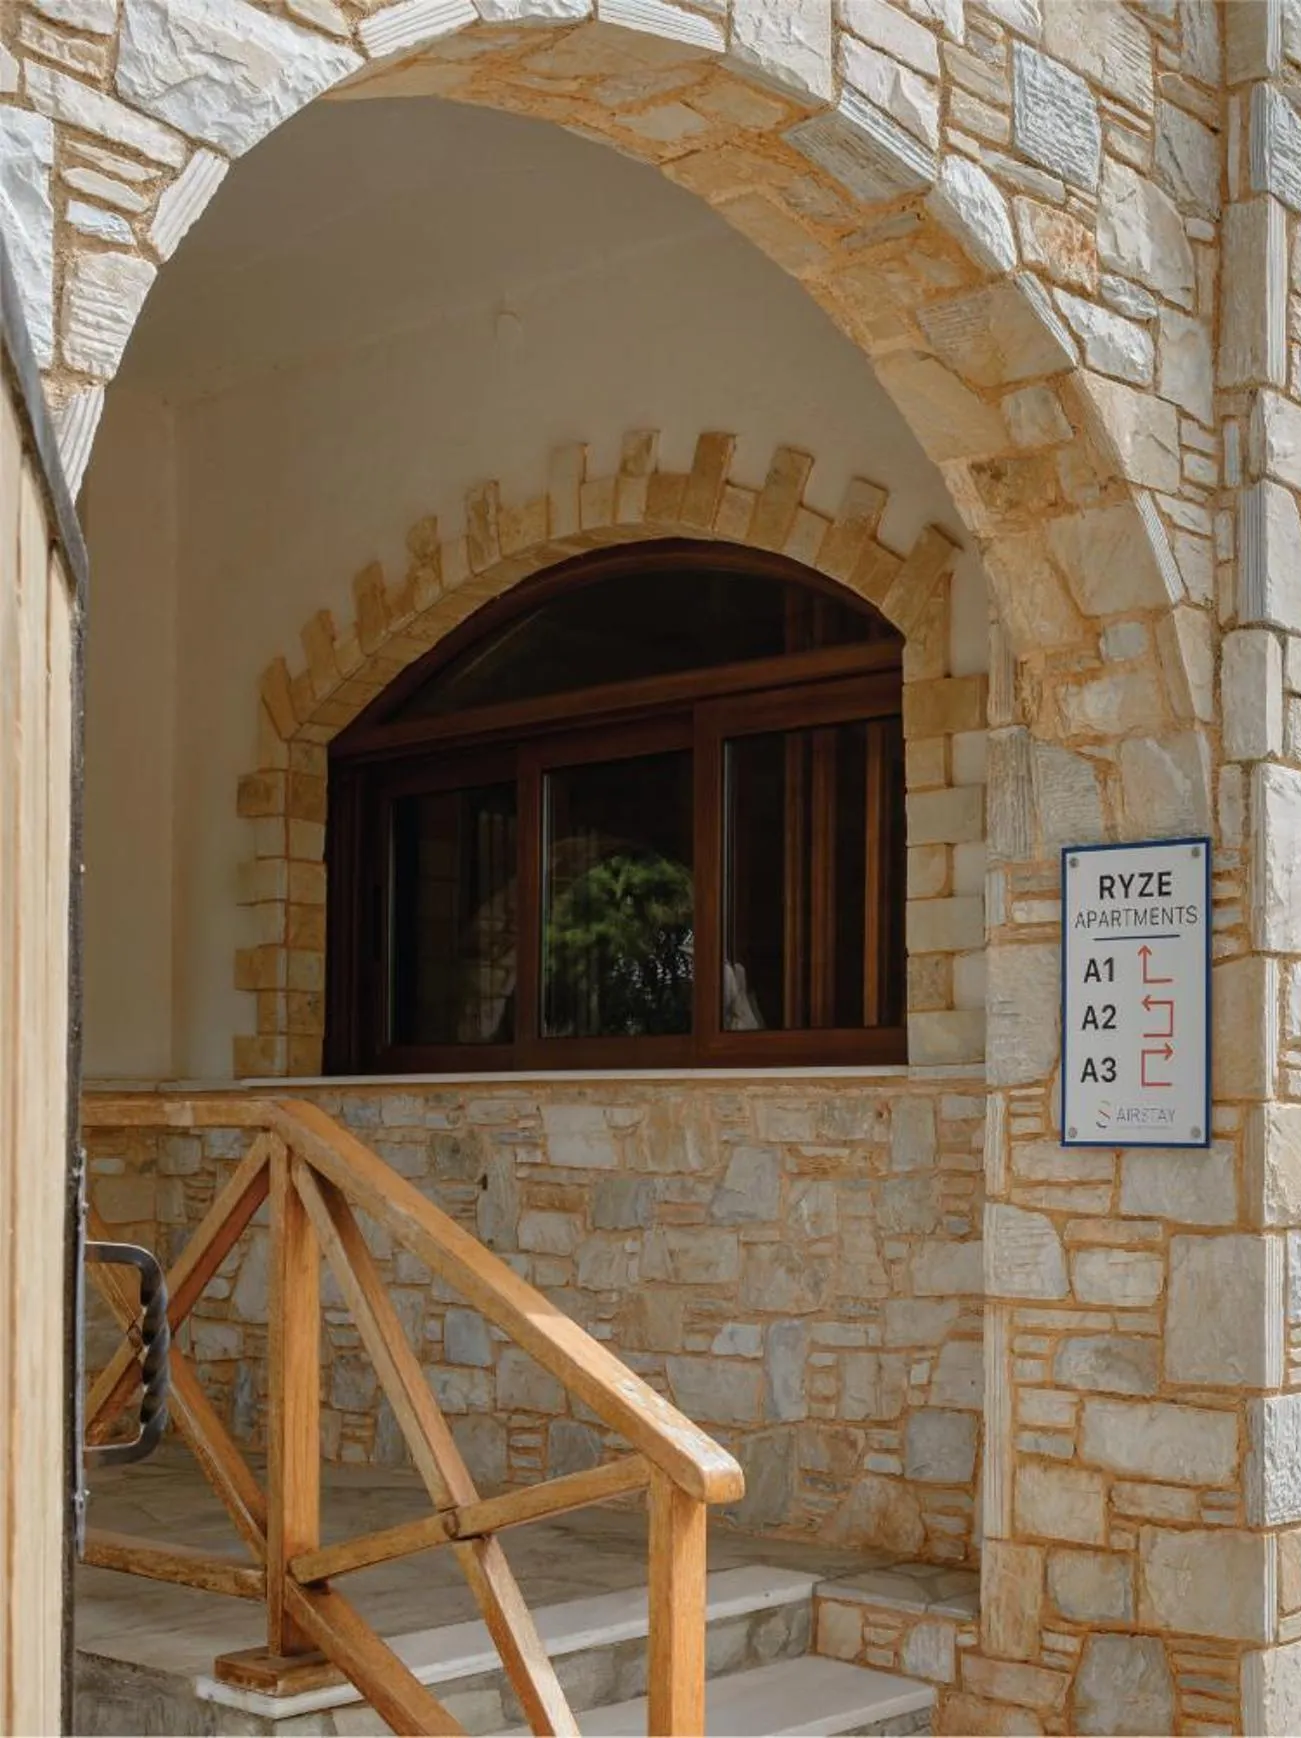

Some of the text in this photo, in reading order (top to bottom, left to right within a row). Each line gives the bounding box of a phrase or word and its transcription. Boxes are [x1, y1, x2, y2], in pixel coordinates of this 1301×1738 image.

[1098, 871, 1172, 900] RYZE
[1074, 905, 1198, 929] APARTMENTS
[1083, 957, 1115, 983] A1
[1081, 1004, 1117, 1030] A2
[1080, 1056, 1117, 1083] A3
